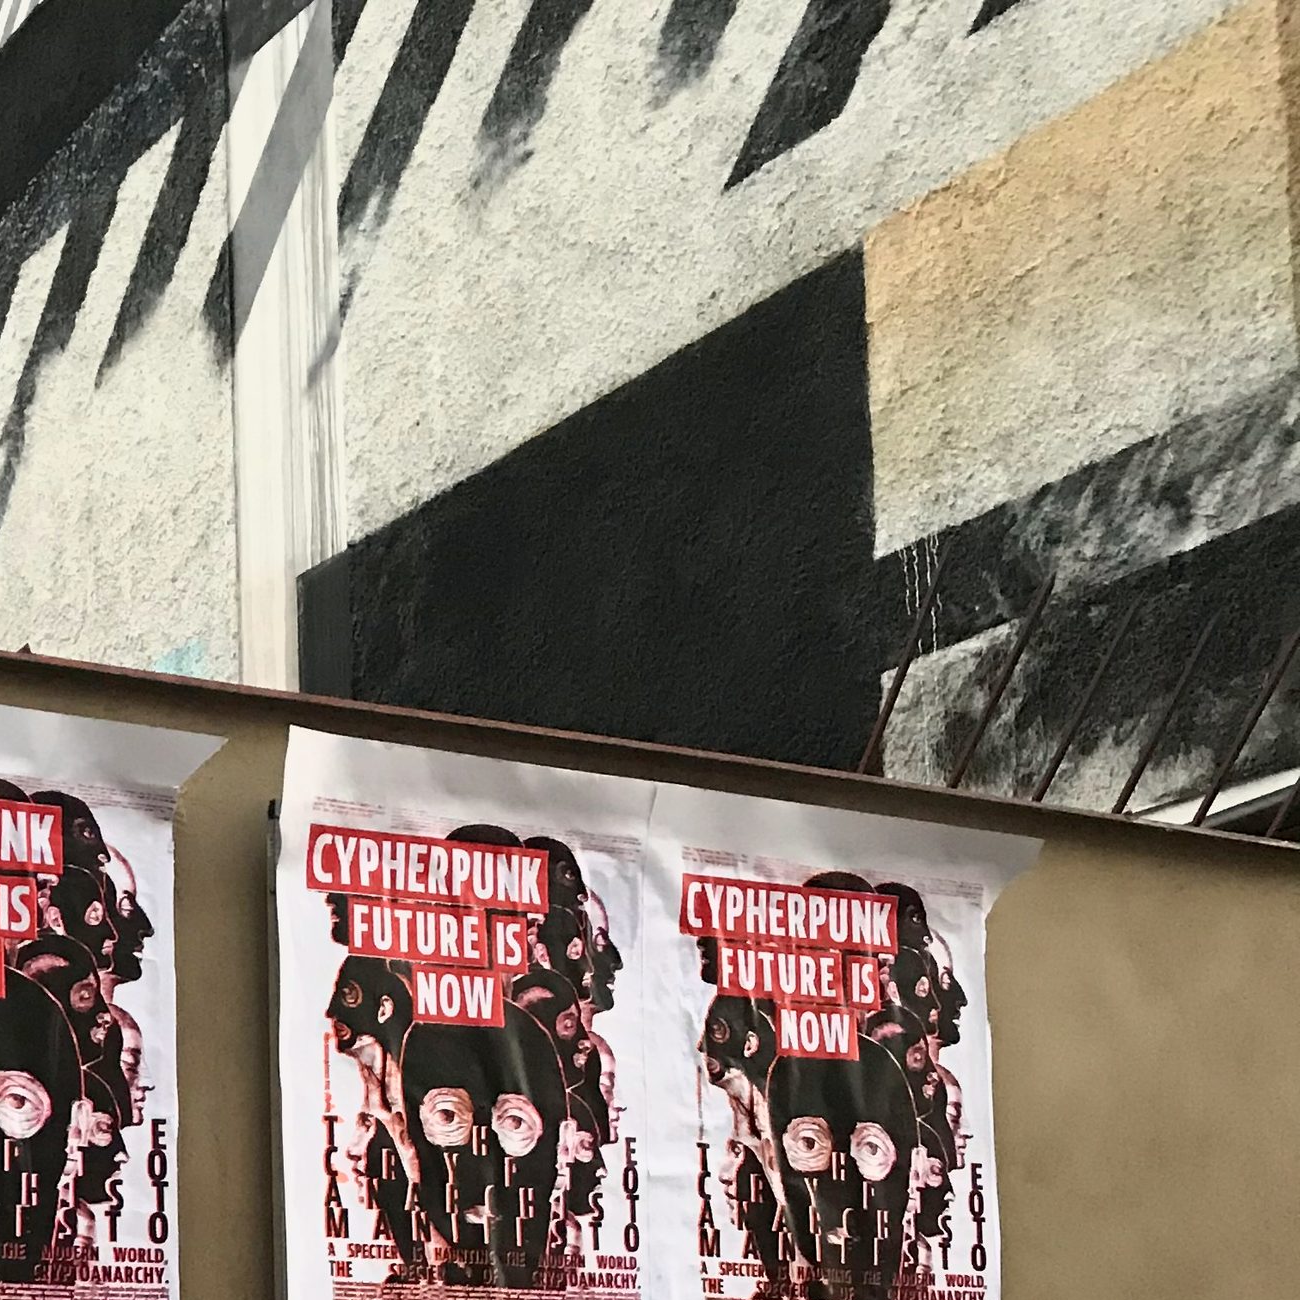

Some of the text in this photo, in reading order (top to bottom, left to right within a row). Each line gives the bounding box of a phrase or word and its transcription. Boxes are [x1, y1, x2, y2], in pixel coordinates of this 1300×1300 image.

[312, 833, 541, 904] CYPHERPUNK
[353, 904, 521, 965] FUTURE IS
[684, 881, 891, 946] CYPHERPUNK
[417, 970, 493, 1019] NOW
[720, 947, 874, 1003] FUTURE IS
[779, 1008, 849, 1053] NOW
[328, 1259, 353, 1277] THE
[346, 1243, 399, 1259] SPECTER
[718, 1261, 765, 1278] SPECTER
[700, 1277, 724, 1294] THE
